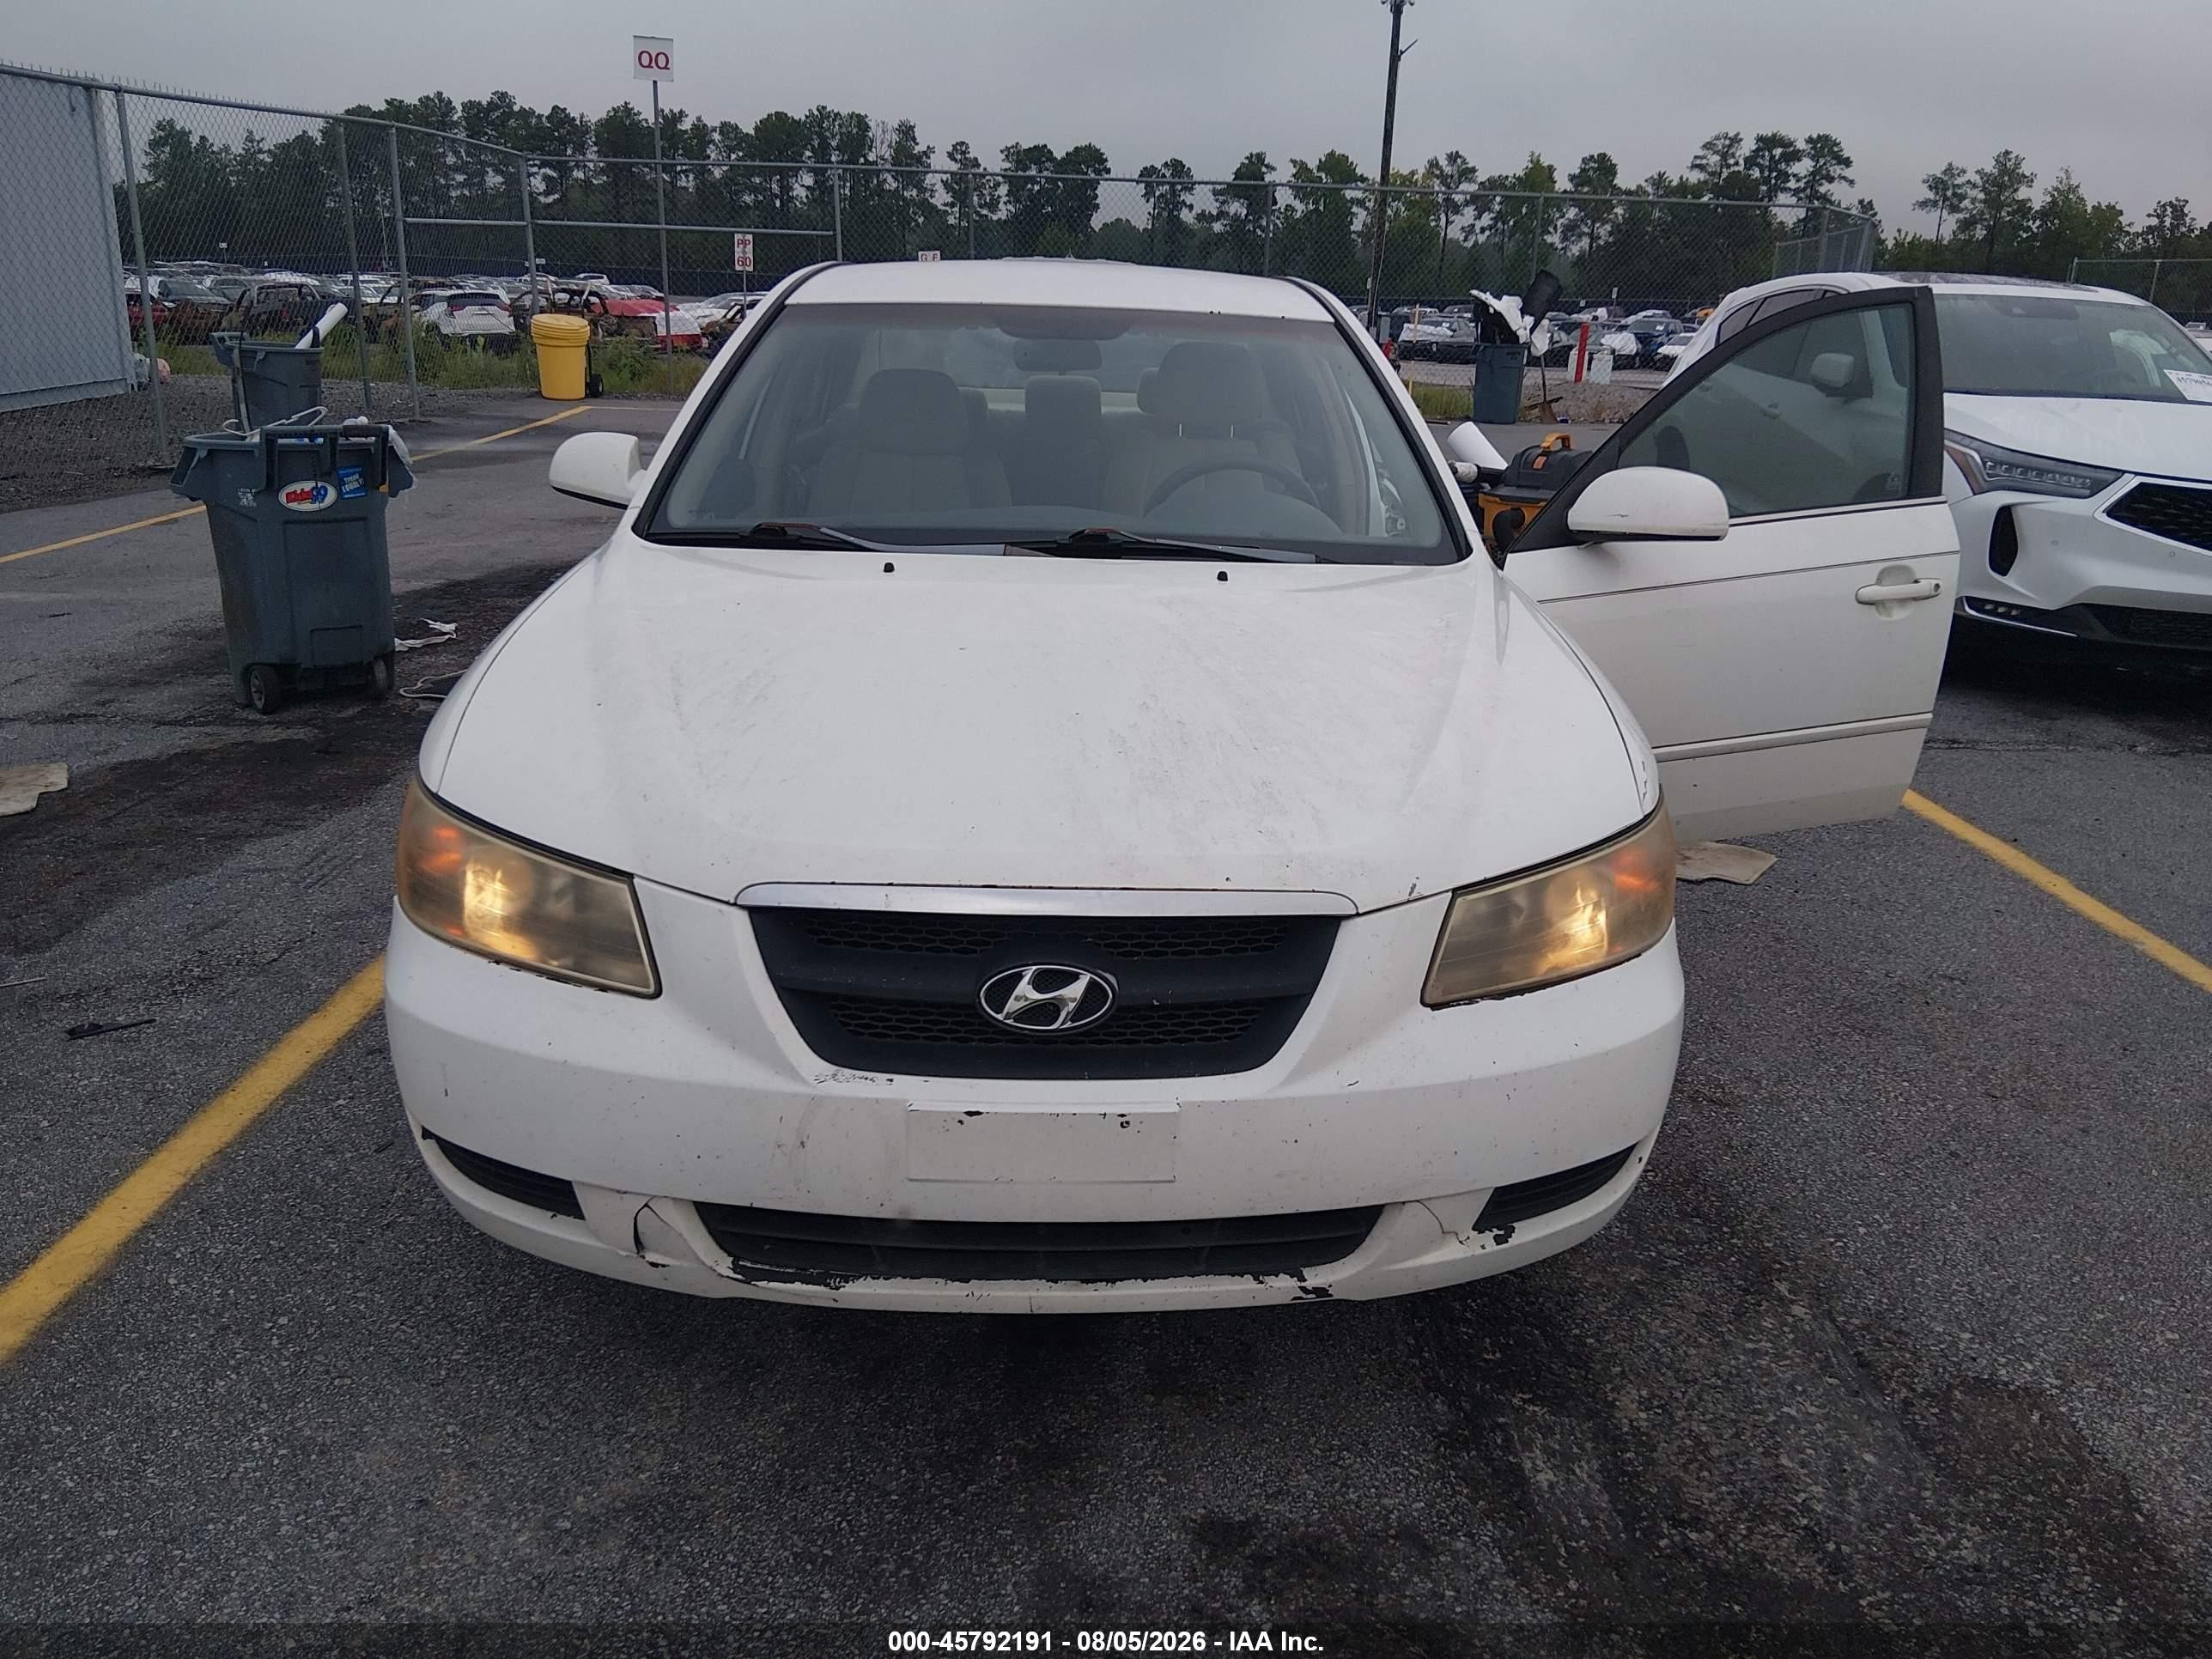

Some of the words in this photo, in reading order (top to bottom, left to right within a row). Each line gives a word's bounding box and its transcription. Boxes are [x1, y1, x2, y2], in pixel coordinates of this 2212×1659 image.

[637, 50, 671, 70] QQ
[737, 239, 751, 249] PP
[737, 256, 752, 268] 60
